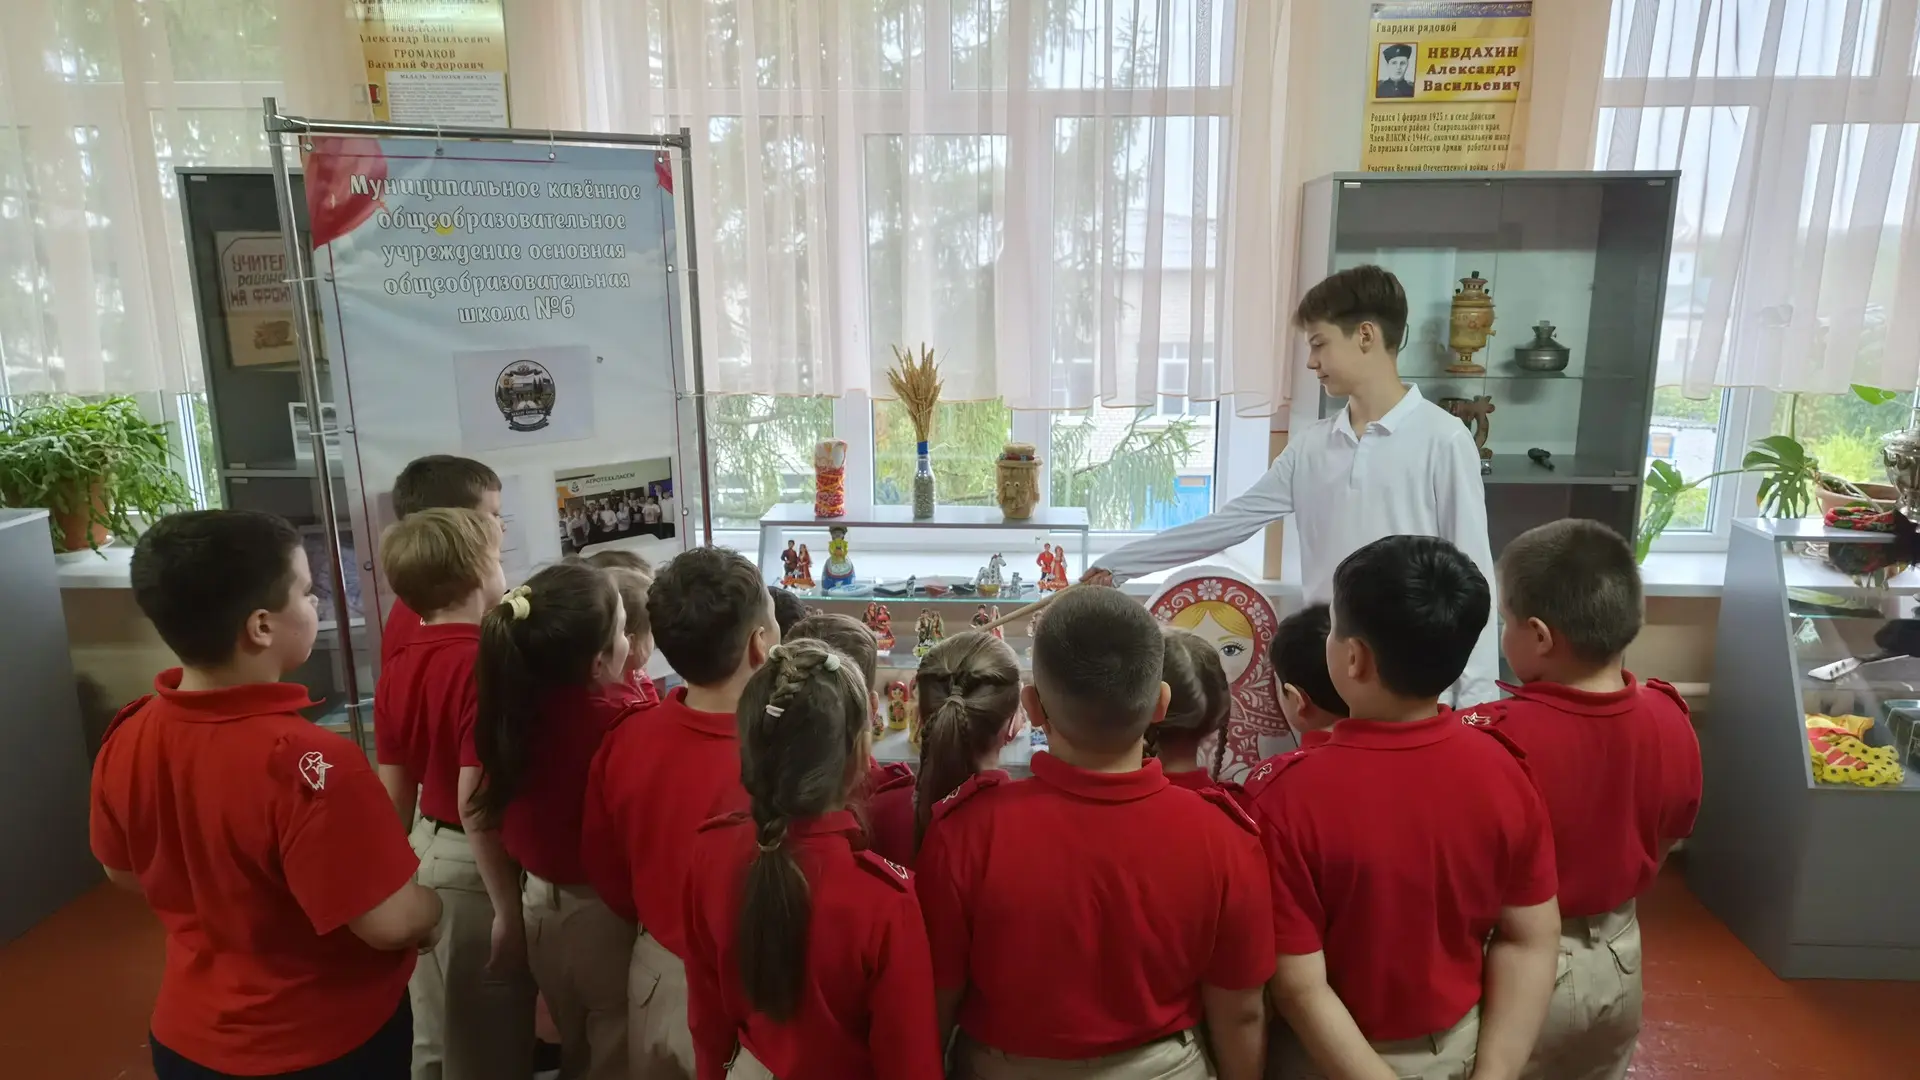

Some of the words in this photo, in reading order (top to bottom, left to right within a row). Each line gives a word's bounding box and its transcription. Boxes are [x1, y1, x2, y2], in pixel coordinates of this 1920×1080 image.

[1376, 22, 1415, 36] Гвардии
[1417, 21, 1457, 35] рядовой
[360, 34, 419, 44] Александр
[423, 34, 490, 43] Васильевич
[394, 48, 456, 59] ГРОМАКОВ
[1428, 46, 1519, 60] НЕВДАХИН
[368, 60, 416, 69] Василий
[421, 60, 484, 71] Федорович
[1426, 63, 1516, 76] Александр
[1423, 80, 1520, 92] Васильевич
[349, 174, 541, 201] Муниципальное
[548, 178, 641, 200] казённое
[377, 205, 627, 234] общеобразовательное
[381, 243, 522, 267] учреждение
[529, 243, 625, 260] основная
[383, 270, 631, 298] общеобразовательная
[458, 303, 530, 324] школа
[534, 295, 575, 321] №6
